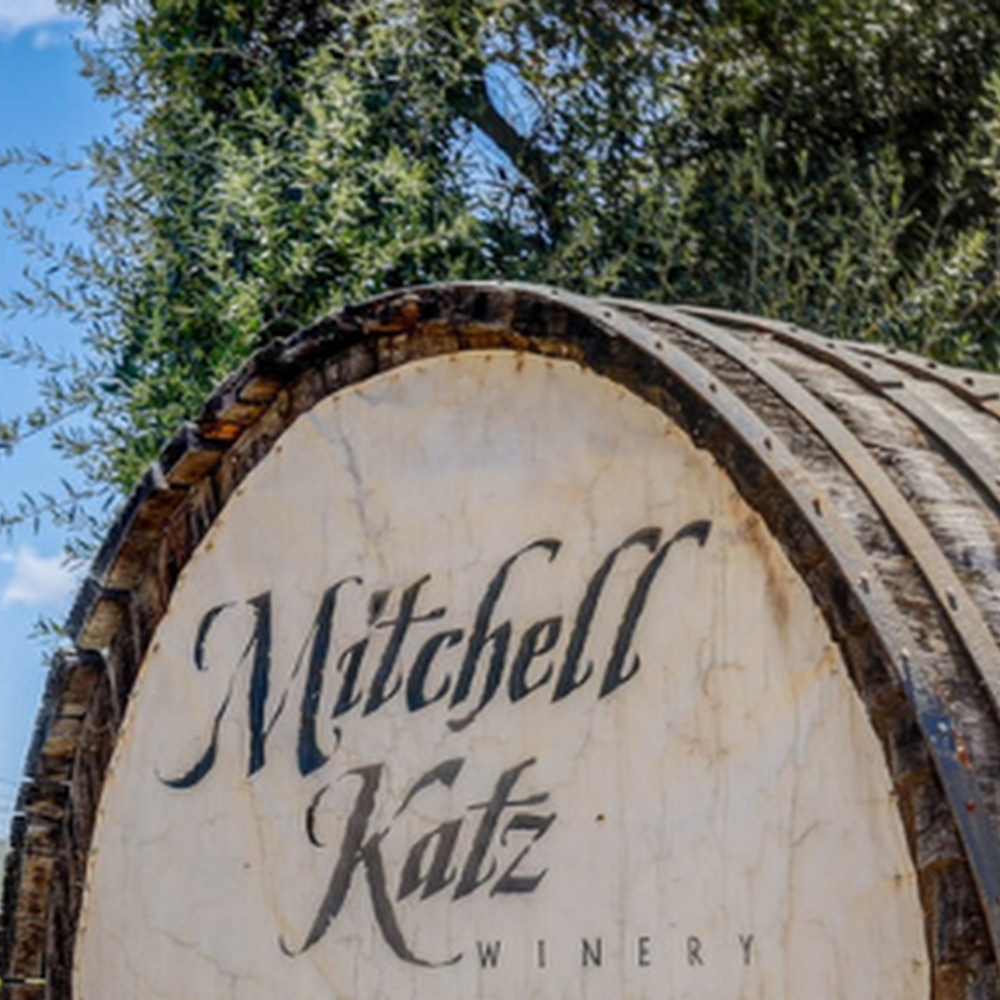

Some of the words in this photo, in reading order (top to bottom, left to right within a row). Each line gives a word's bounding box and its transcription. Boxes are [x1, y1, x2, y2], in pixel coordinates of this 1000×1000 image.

[156, 520, 712, 789] Mitchell
[279, 758, 556, 967] Katz
[477, 935, 755, 968] WINERY
